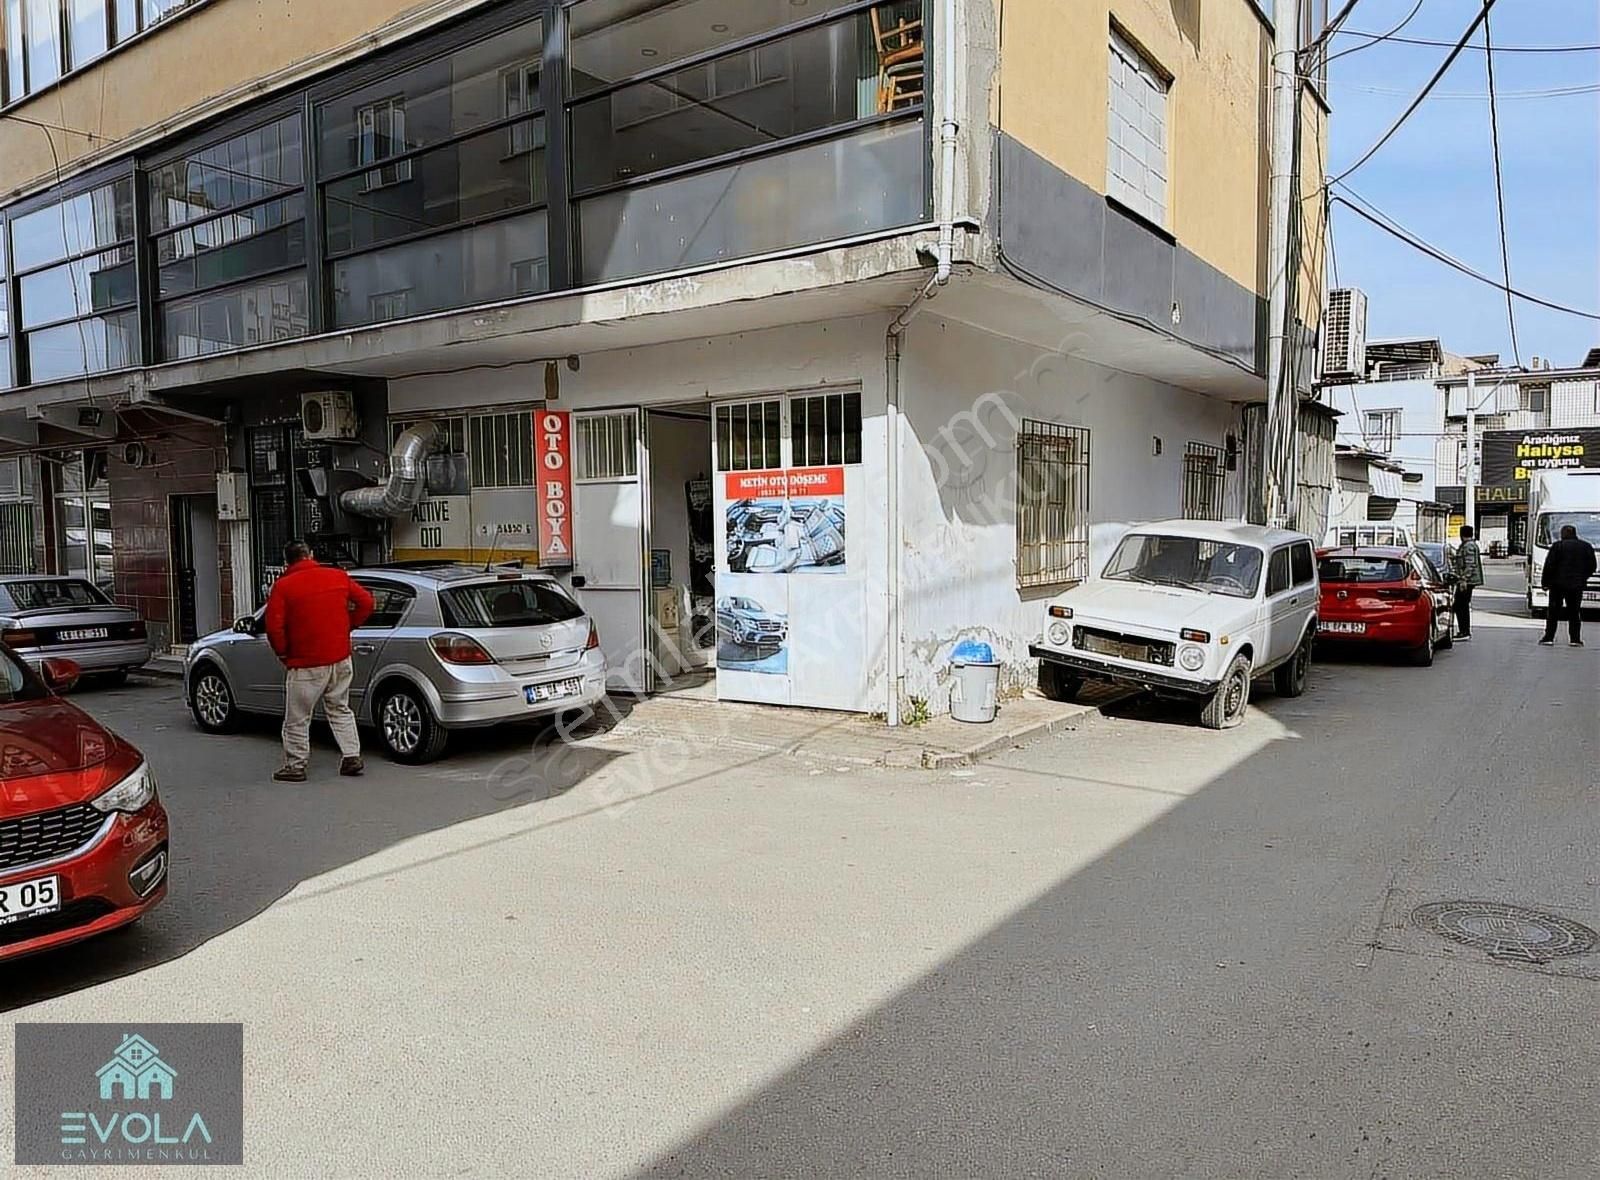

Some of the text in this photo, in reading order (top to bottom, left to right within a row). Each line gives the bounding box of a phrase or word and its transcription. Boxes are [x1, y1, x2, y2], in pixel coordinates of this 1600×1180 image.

[1516, 444, 1584, 458] Halıysa
[1521, 458, 1580, 468] en uygunu
[543, 414, 567, 553] OTO BOYA
[1476, 487, 1523, 501] HALI
[420, 526, 442, 548] OTO
[20, 879, 54, 908] 05
